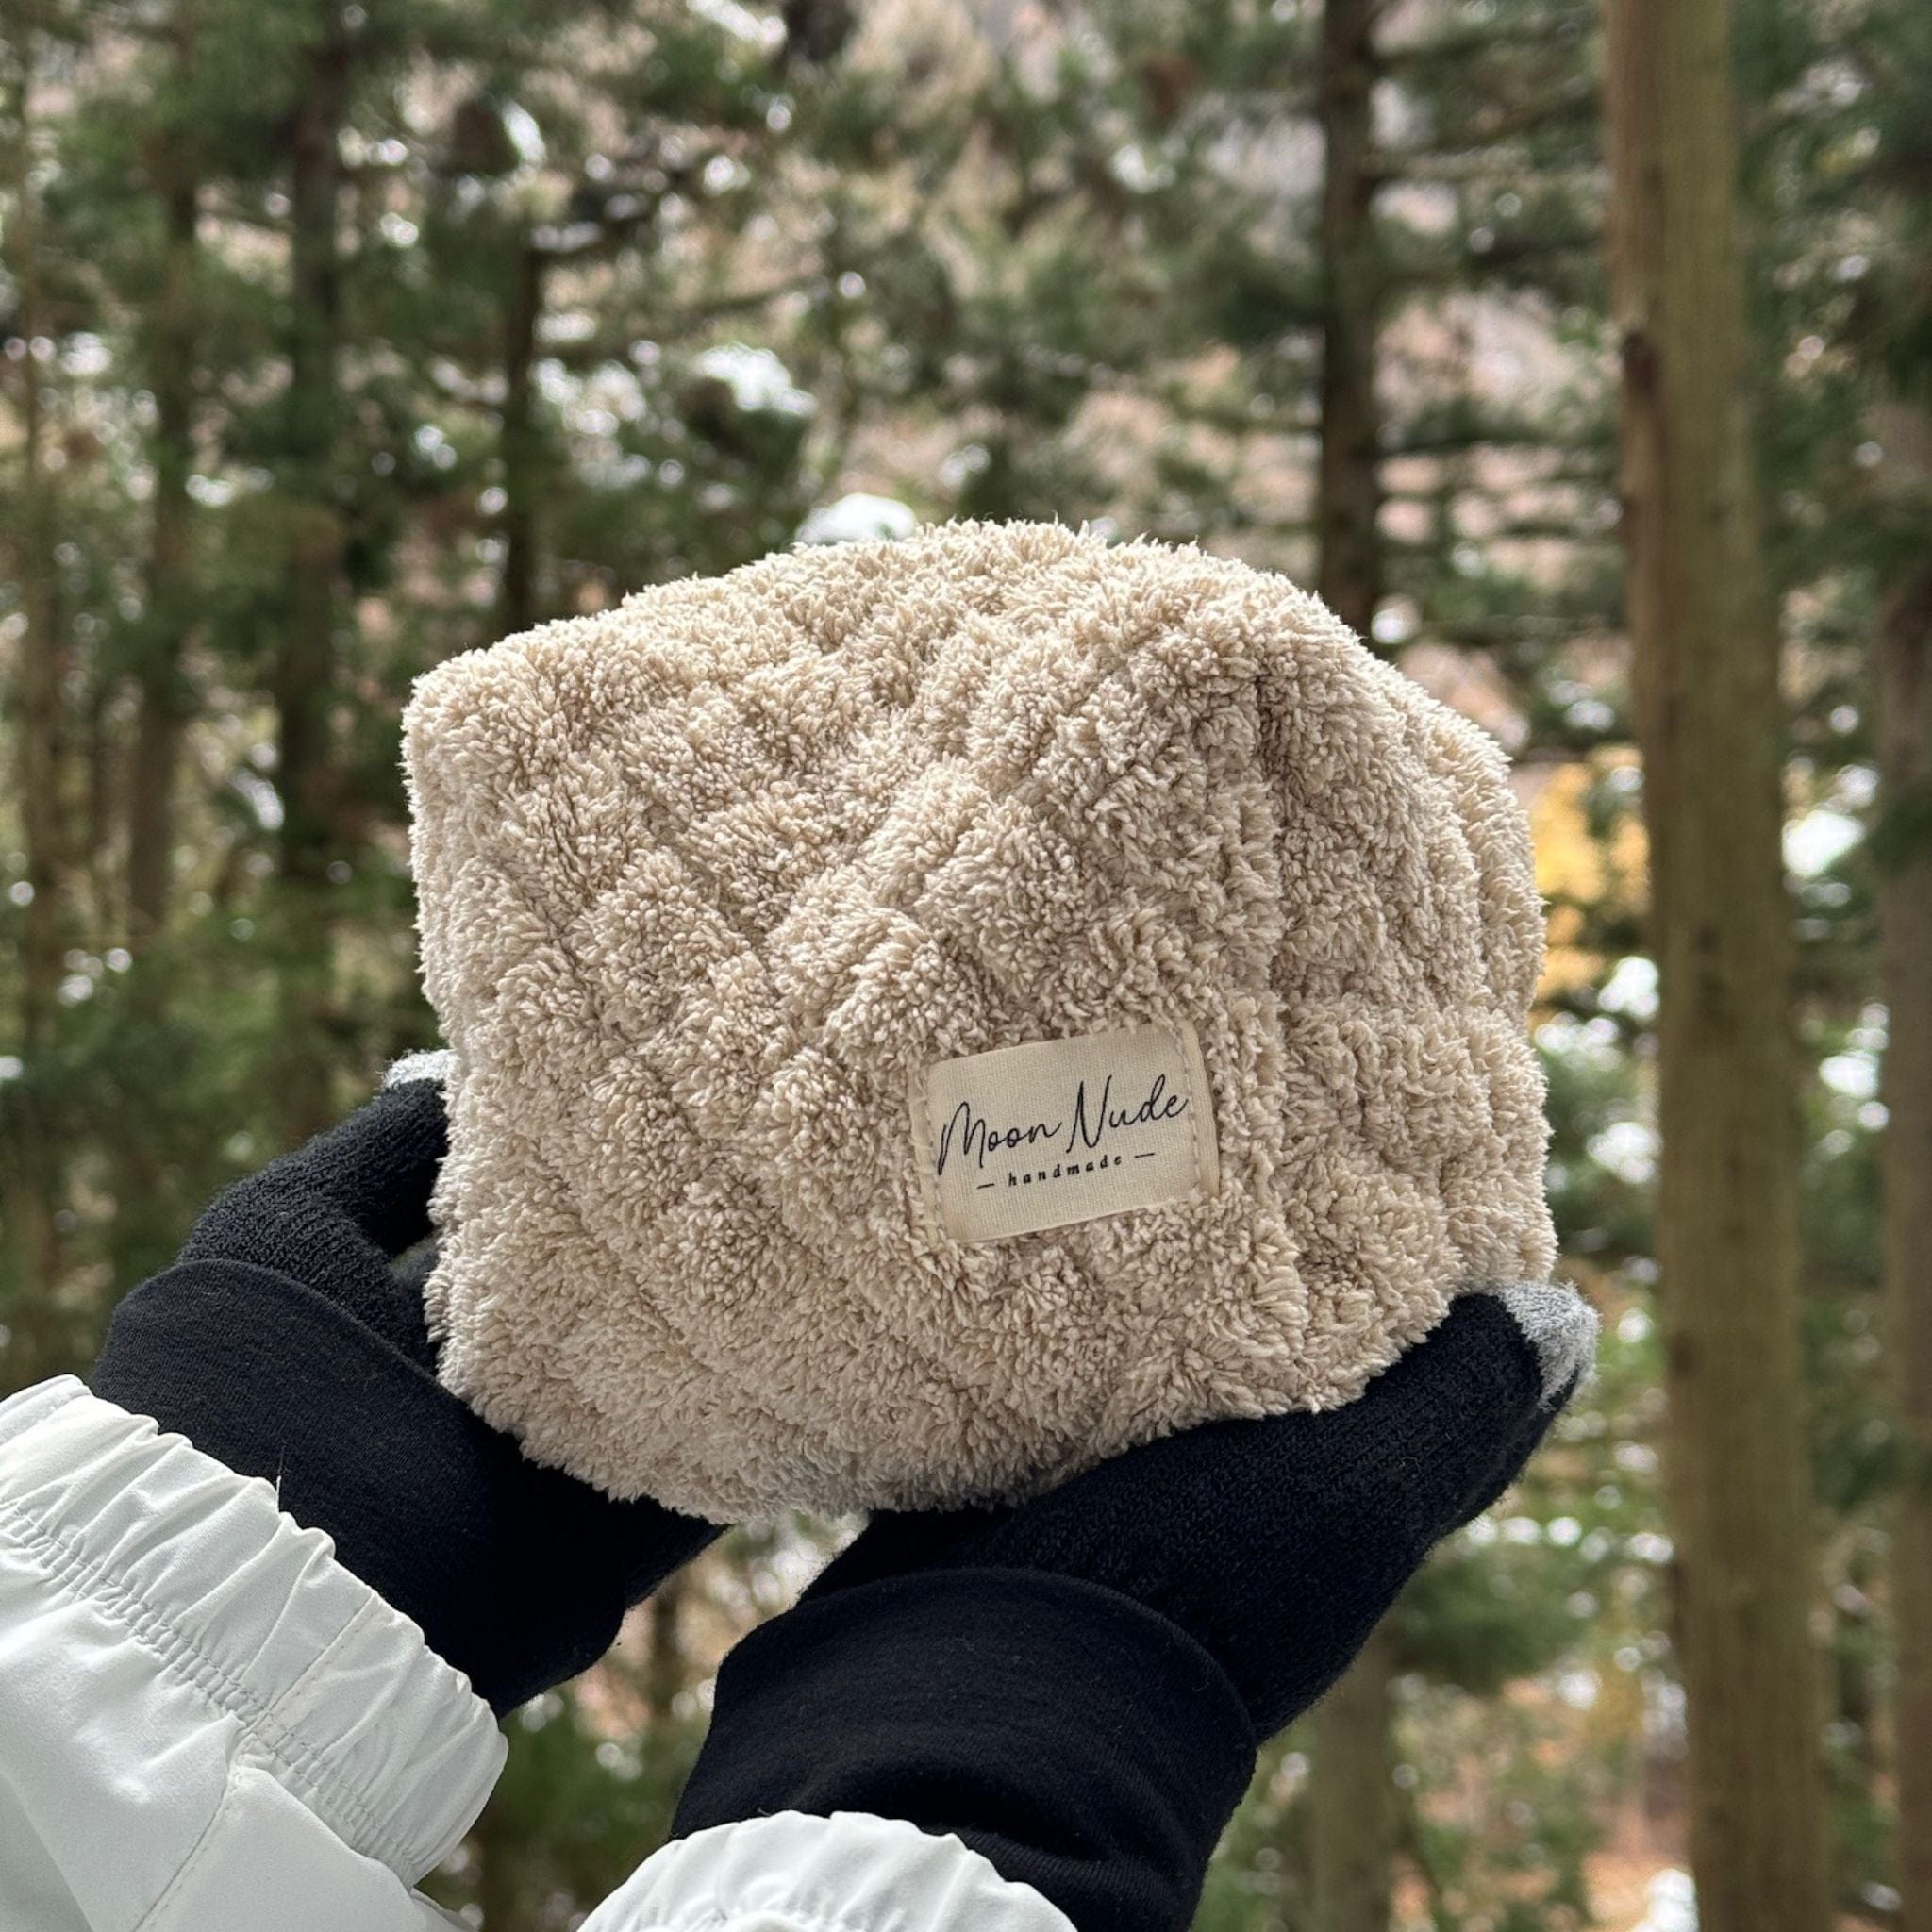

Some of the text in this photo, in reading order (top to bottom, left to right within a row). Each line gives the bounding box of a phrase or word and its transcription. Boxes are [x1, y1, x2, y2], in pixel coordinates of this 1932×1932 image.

[938, 1074, 1189, 1175] Moon Nude
[1008, 1154, 1123, 1187] handmade
